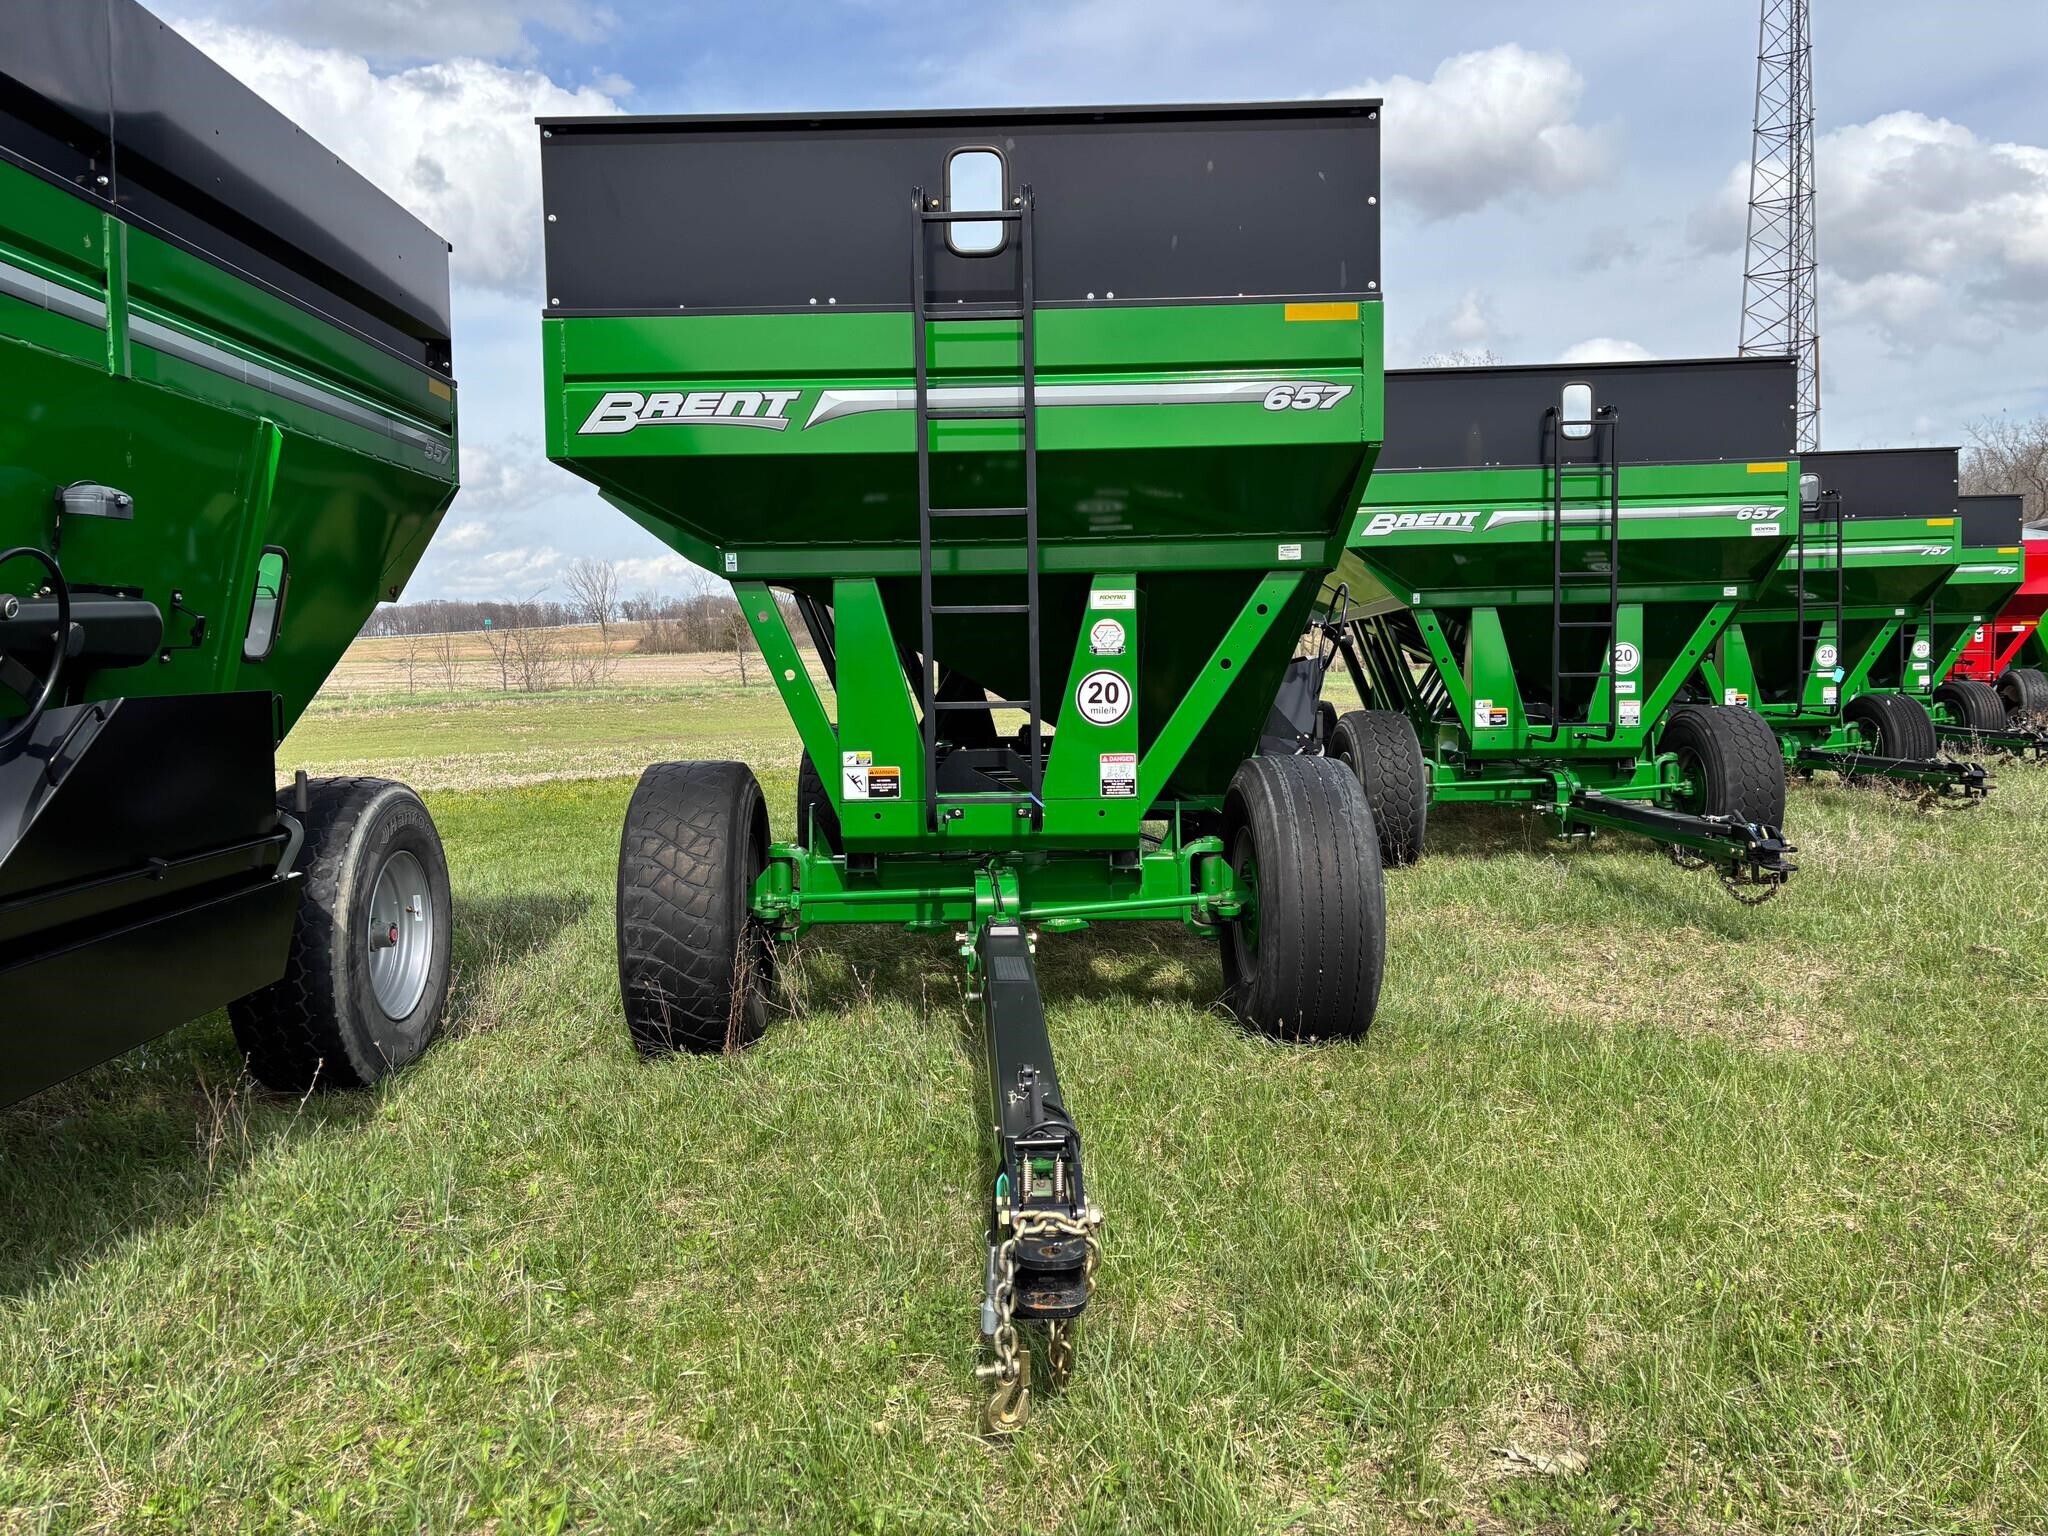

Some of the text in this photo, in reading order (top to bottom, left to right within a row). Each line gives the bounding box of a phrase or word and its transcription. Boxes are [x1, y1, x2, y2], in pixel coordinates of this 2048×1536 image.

[1263, 384, 1354, 411] 657
[576, 390, 802, 435] BRENT
[424, 439, 451, 465] 557
[1736, 505, 1786, 520] 657
[1360, 511, 1481, 536] BRENT
[1920, 545, 1952, 556] 757
[1993, 567, 2017, 575] 757
[1615, 649, 1632, 662] 20
[1821, 649, 1834, 659] 20
[1088, 681, 1119, 704] 20
[1090, 706, 1118, 715] mile/h
[1109, 755, 1134, 763] DANGER
